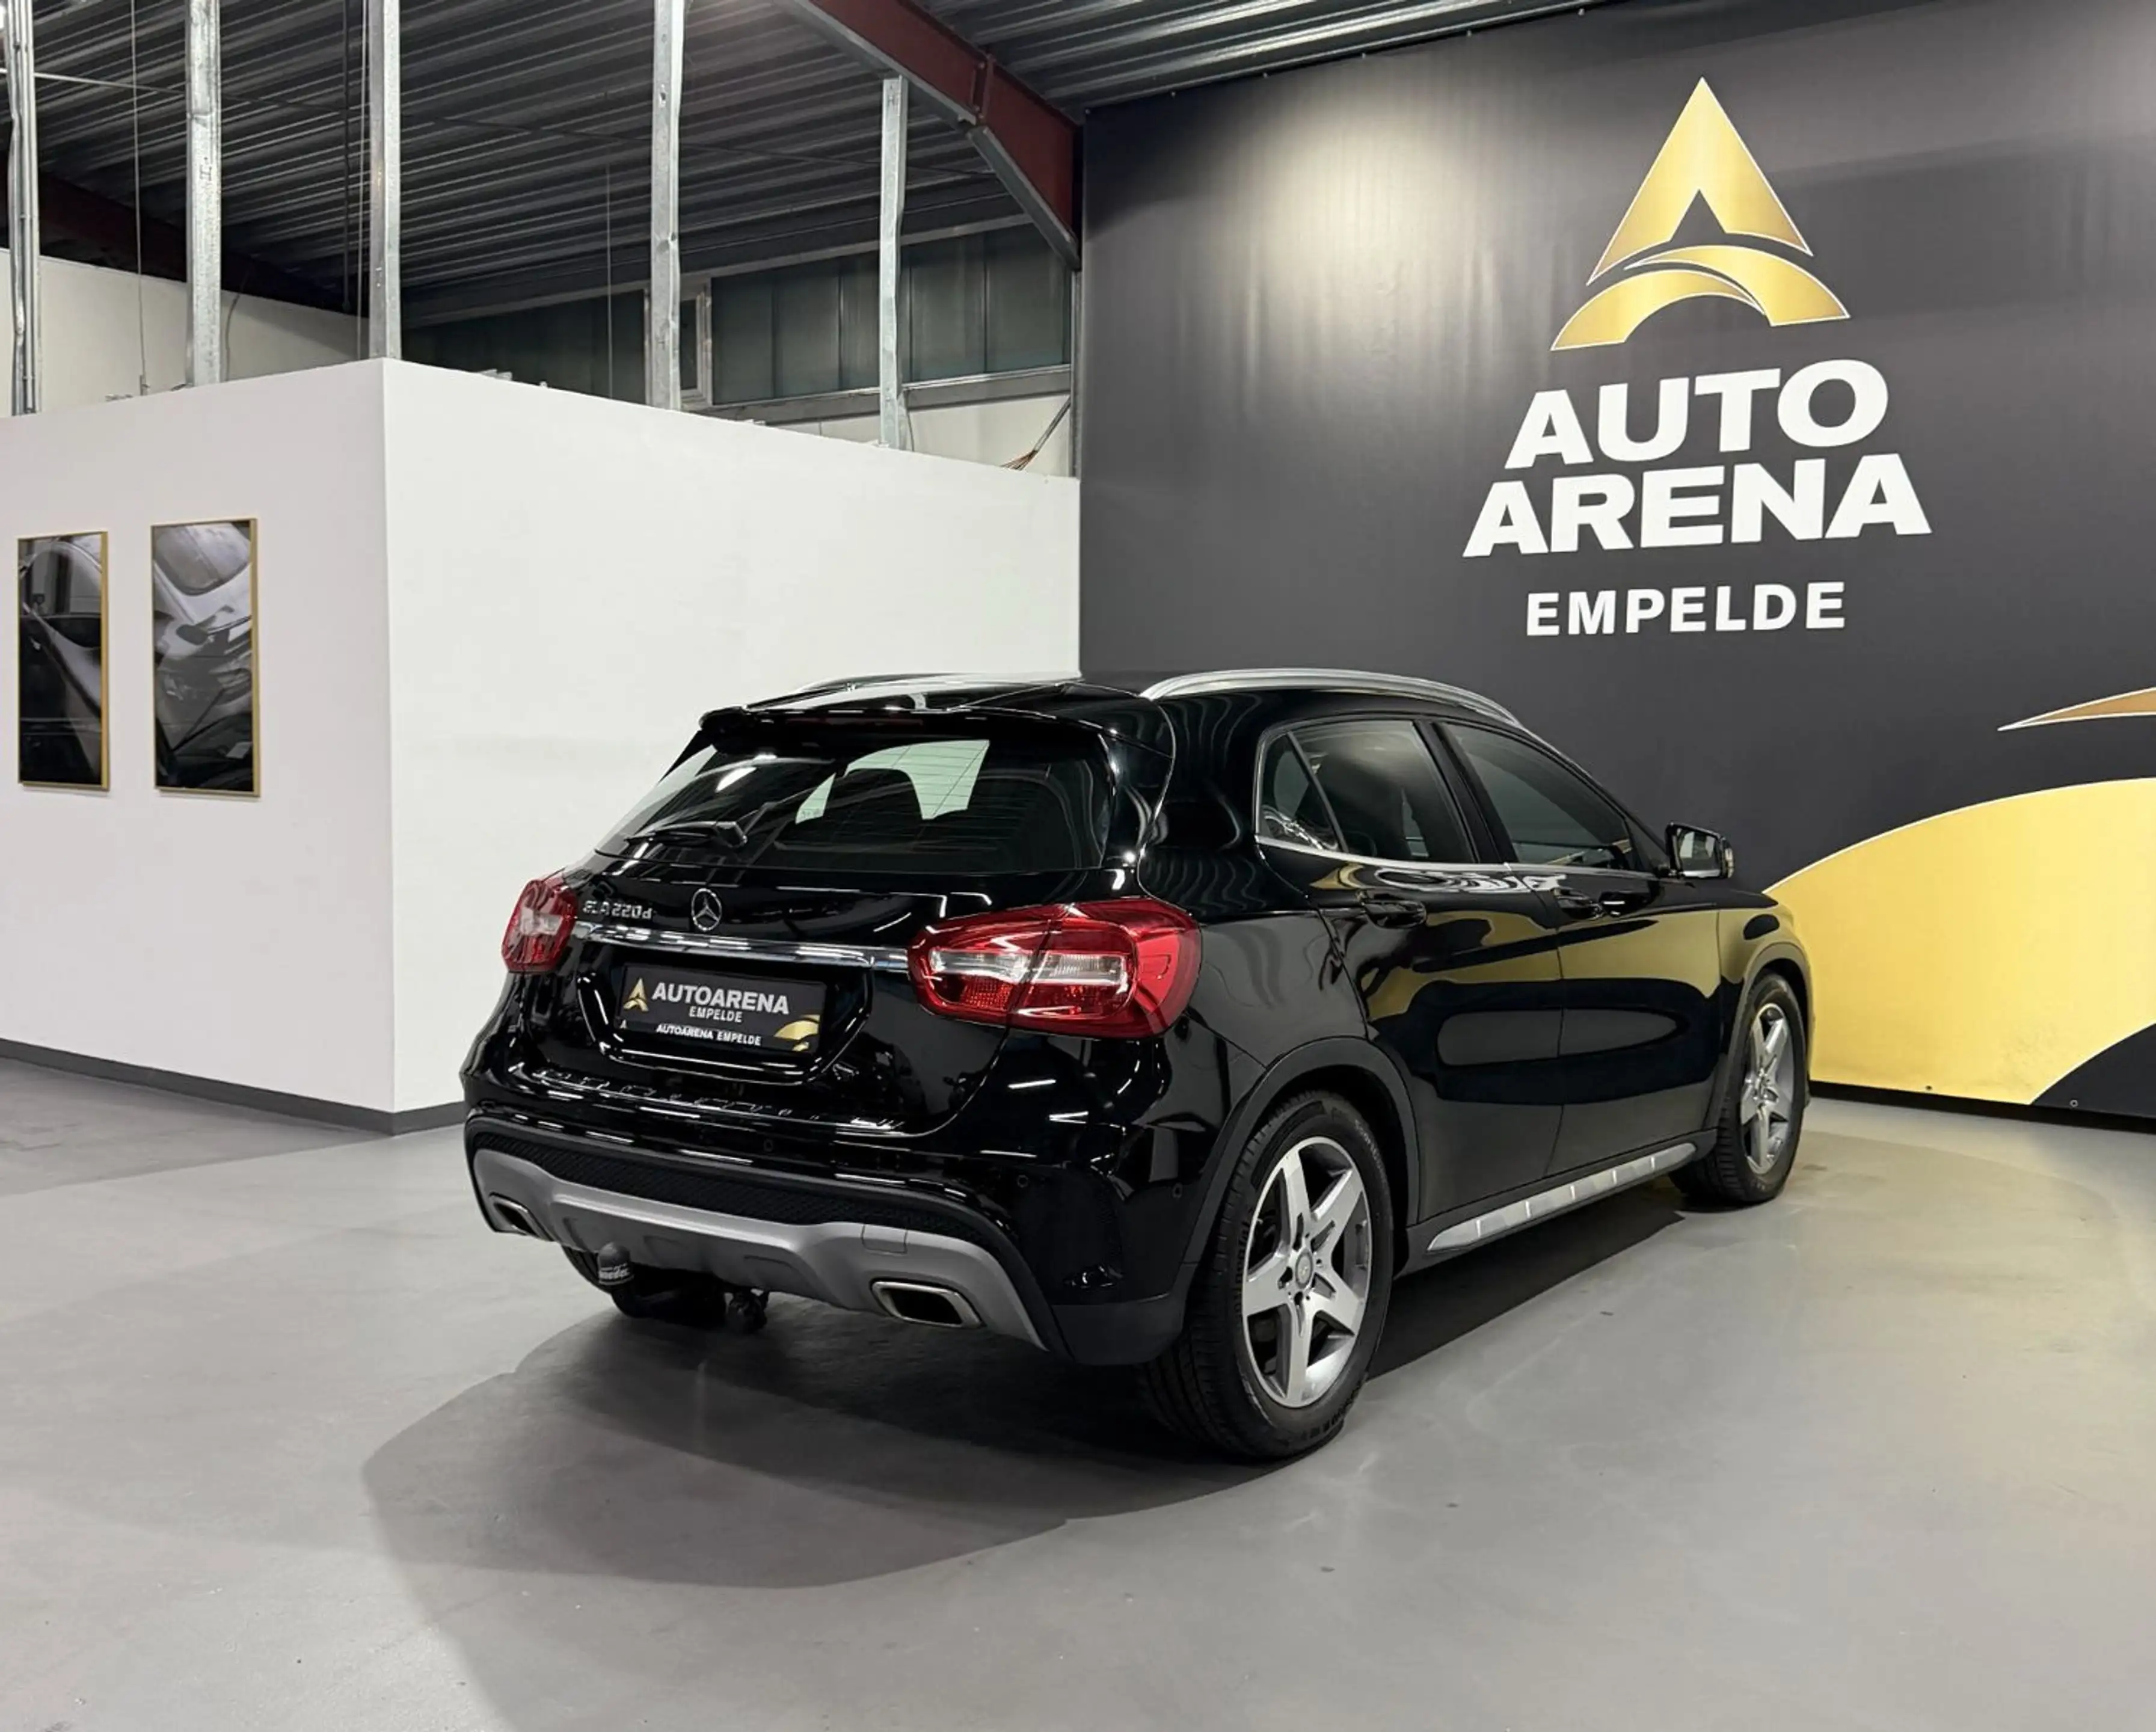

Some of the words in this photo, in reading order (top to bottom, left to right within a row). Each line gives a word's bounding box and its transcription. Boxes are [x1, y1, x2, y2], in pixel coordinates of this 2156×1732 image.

[1504, 359, 1888, 469] AUTO
[1463, 453, 1932, 558] ARENA
[1526, 581, 1845, 636] EMPELDE
[652, 982, 789, 1015] AUTOARENA
[689, 1006, 743, 1023] EMPELDE
[656, 1023, 713, 1040] AUTOARENA
[716, 1029, 762, 1046] EMPELDE
